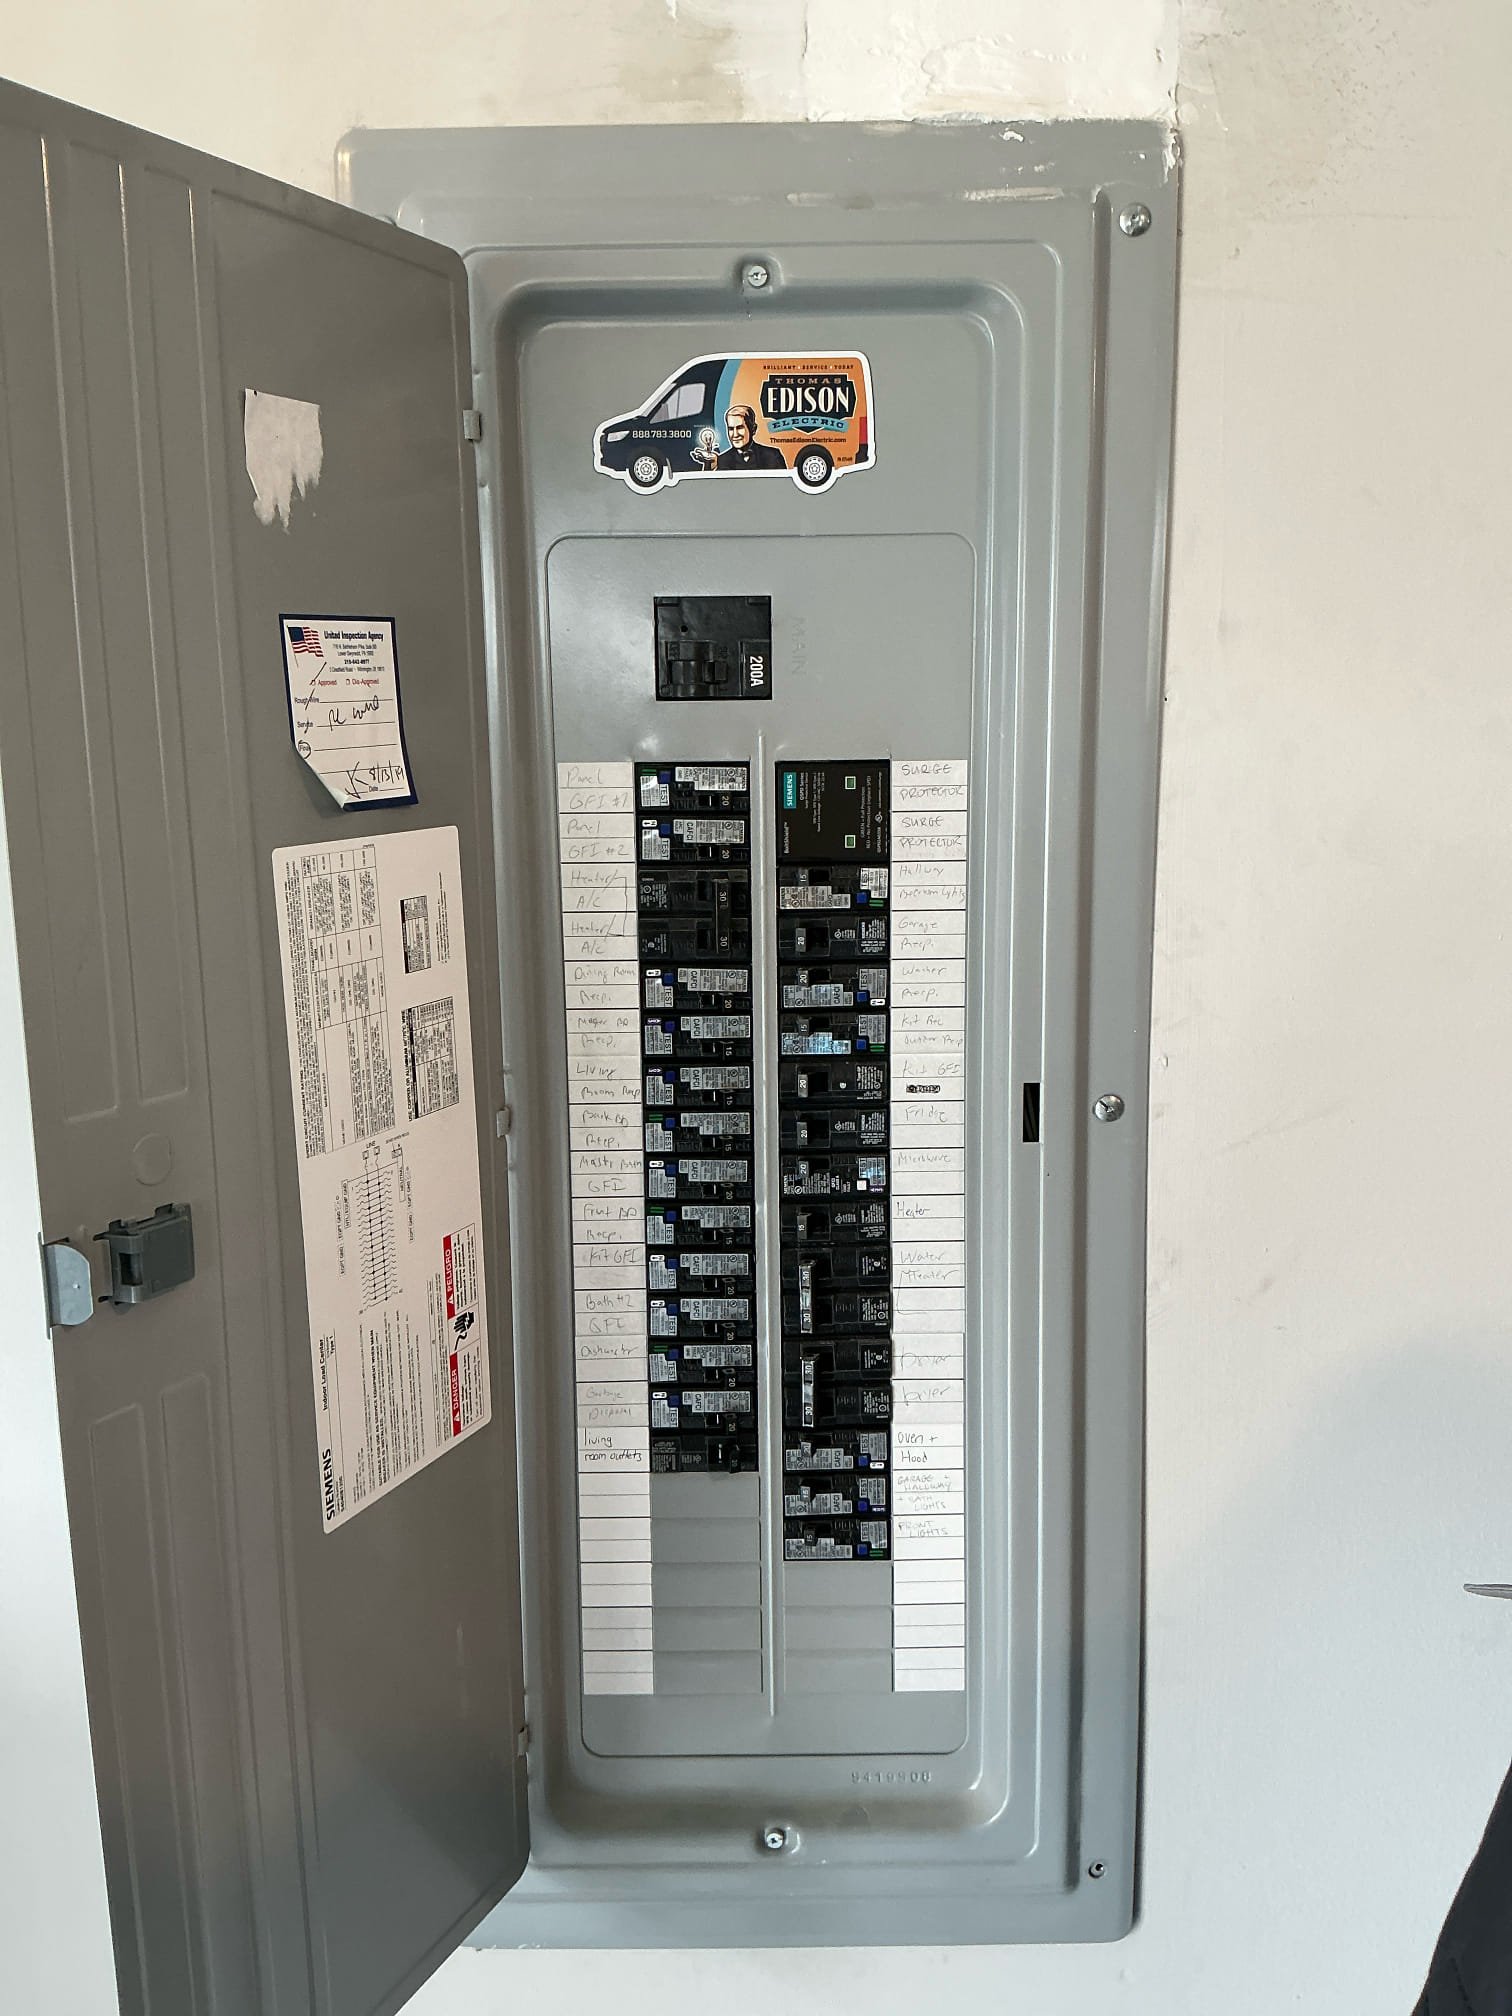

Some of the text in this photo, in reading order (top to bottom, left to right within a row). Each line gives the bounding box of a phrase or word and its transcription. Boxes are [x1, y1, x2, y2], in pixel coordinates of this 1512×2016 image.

[774, 377, 842, 385] THOMAS
[767, 387, 850, 413] EDISON
[771, 416, 844, 430] ELECTRIC
[323, 631, 384, 642] United Inspection Agency
[791, 617, 807, 675] MAIN
[749, 655, 764, 687] 200A
[901, 763, 953, 776] SURGE
[568, 792, 610, 810] GFI
[660, 784, 670, 806] TEST
[720, 795, 730, 806] 20
[899, 786, 964, 801] PROTECTOR
[901, 817, 944, 828] SURGE
[685, 821, 695, 842] CAFCI
[899, 835, 962, 848] PROTECTOR
[568, 844, 600, 859] GFI
[660, 838, 671, 861] TEST
[721, 849, 730, 860] 20
[799, 873, 808, 883] 15
[860, 868, 869, 889] TEST
[576, 891, 601, 909] A/C
[718, 891, 727, 903] 30
[580, 940, 606, 954] A/C
[719, 935, 728, 947] 30
[797, 936, 806, 946] 20
[799, 974, 809, 984] 20
[860, 970, 868, 989] TEST
[664, 986, 673, 1007] TEST
[833, 986, 841, 1005] CAFCI
[723, 999, 733, 1009] 20
[692, 1018, 700, 1038] CAFCI
[800, 1023, 809, 1033] 15
[859, 1015, 867, 1035] TEST
[664, 1033, 673, 1055] TEST
[724, 1046, 733, 1056] 15
[405, 1077, 411, 1086] OR
[692, 1069, 700, 1089] CAFCI
[799, 1079, 808, 1089] 20
[664, 1084, 673, 1105] TEST
[724, 1095, 733, 1106] 15
[664, 1130, 673, 1152] TEST
[800, 1129, 808, 1138] 20
[365, 1140, 377, 1148] LINE
[724, 1143, 732, 1152] 15
[691, 1161, 700, 1180] CAFCI
[799, 1164, 808, 1175] 20
[859, 1157, 868, 1178] TEST
[587, 1178, 626, 1192] GFI
[667, 1177, 676, 1198] TEST
[724, 1190, 734, 1200] 20
[896, 1201, 931, 1219] Heater
[666, 1223, 674, 1245] TEST
[798, 1224, 806, 1232] 15
[725, 1237, 733, 1245] 15
[444, 1248, 453, 1292] PELIGRO
[692, 1255, 700, 1275] CAFCI
[667, 1268, 676, 1289] TEST
[802, 1271, 811, 1282] 30
[727, 1286, 735, 1295] 20
[692, 1300, 700, 1320] CAFCI
[668, 1315, 677, 1336] TEST
[803, 1313, 812, 1324] 30
[726, 1331, 734, 1341] 20
[317, 1338, 325, 1364] Center
[667, 1360, 677, 1381] TEST
[805, 1365, 813, 1376] 30
[450, 1368, 459, 1410] DANGER
[728, 1377, 736, 1388] 20
[320, 1385, 329, 1411] Indoor
[693, 1393, 703, 1412] CAFCI
[668, 1407, 679, 1428] TEST
[805, 1406, 813, 1416] 30
[728, 1422, 737, 1432] 20
[583, 1427, 613, 1448] living
[860, 1433, 869, 1454] TEST
[897, 1431, 939, 1445] Oven +
[583, 1449, 643, 1463] room outlets
[833, 1450, 842, 1468] CAFCI
[901, 1451, 928, 1464] Hood
[321, 1448, 336, 1521] SIEMENS
[859, 1478, 868, 1499] TEST
[802, 1489, 810, 1499] 15
[832, 1495, 842, 1513] CAFCI
[805, 1533, 813, 1542] 15
[861, 1521, 869, 1542] TEST
